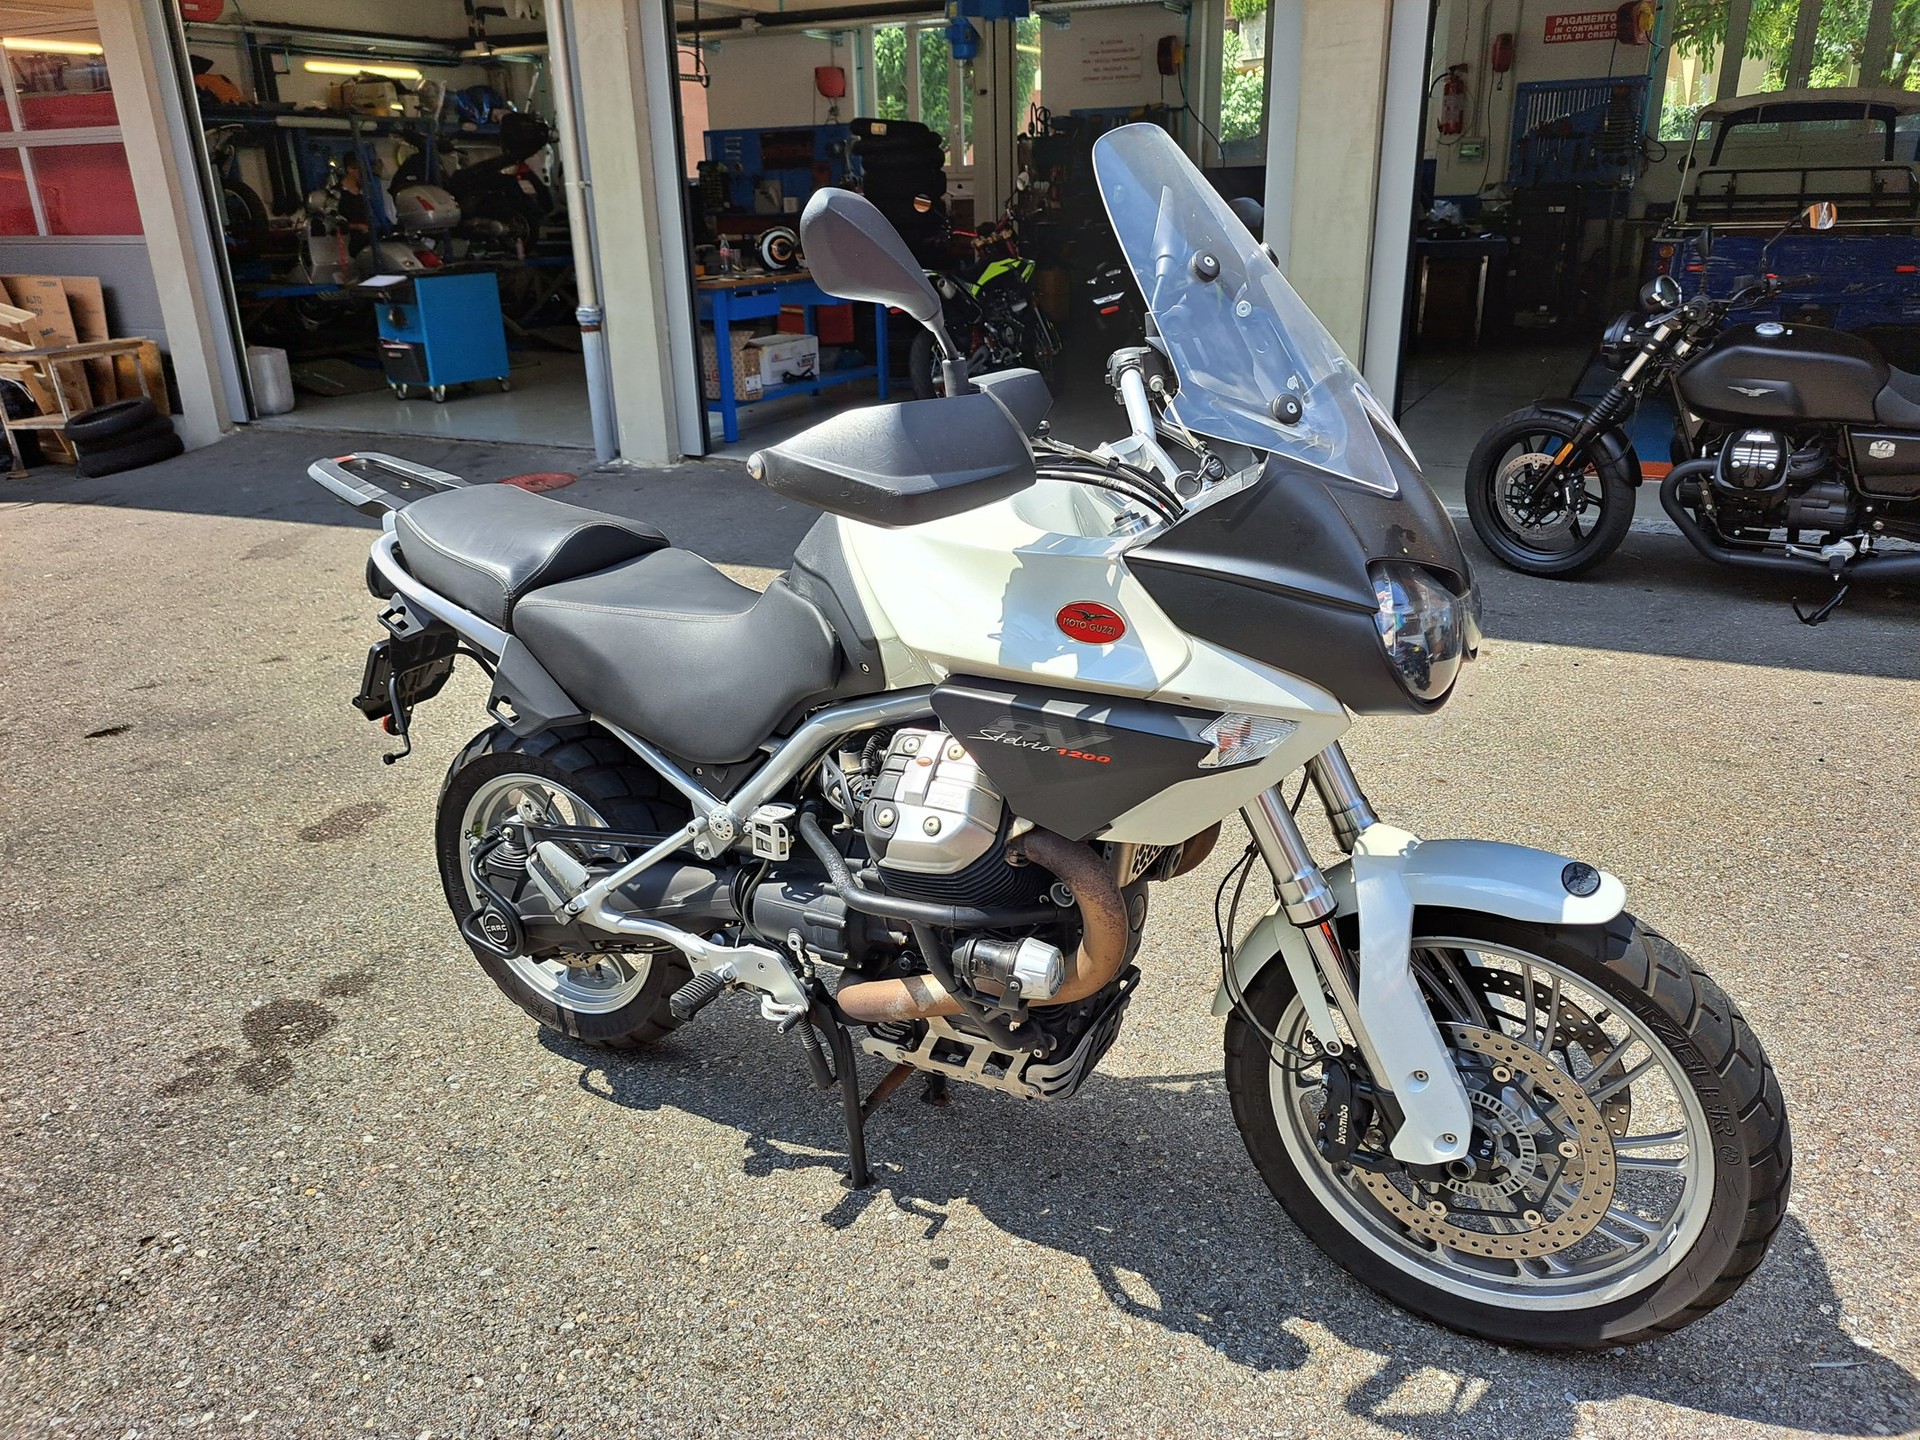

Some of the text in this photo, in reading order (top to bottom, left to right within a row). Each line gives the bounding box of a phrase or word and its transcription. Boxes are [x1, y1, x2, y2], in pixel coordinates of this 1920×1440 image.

[1555, 13, 1617, 26] PAGAMENTO
[1565, 24, 1607, 32] CONTANTI
[1587, 30, 1617, 39] CREDIT
[1063, 617, 1116, 636] MOTO GUZZI
[967, 729, 1111, 763] Stelvio 1200
[1608, 978, 1736, 1136] ETZELER
[1335, 1104, 1349, 1145] brembo
